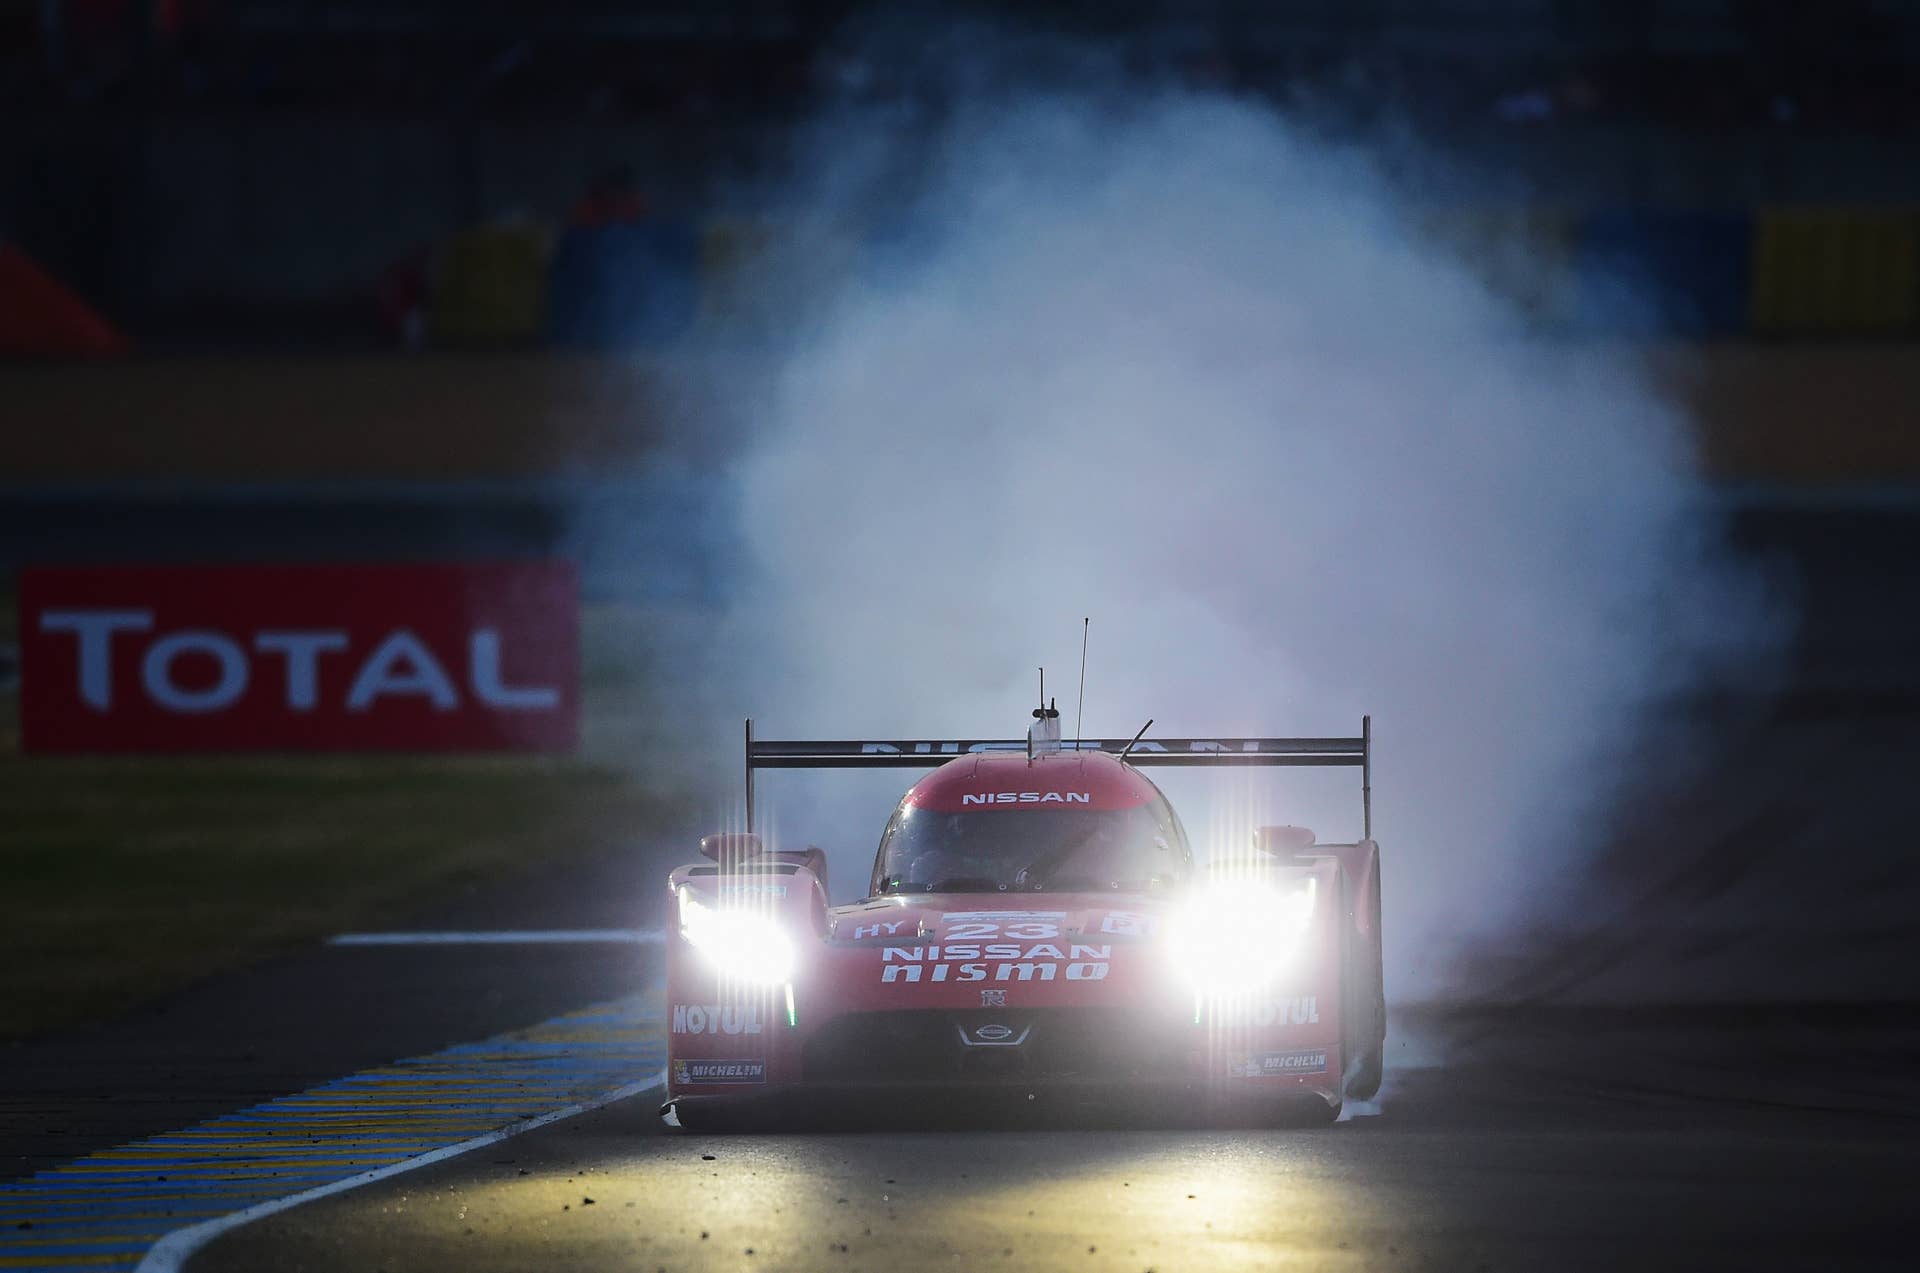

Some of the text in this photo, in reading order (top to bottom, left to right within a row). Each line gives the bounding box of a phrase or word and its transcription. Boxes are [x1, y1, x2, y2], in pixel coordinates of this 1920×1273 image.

[39, 609, 560, 712] TOTAL
[963, 792, 1090, 805] NISSAN
[854, 920, 905, 939] HY
[944, 922, 1060, 940] 23
[882, 944, 1111, 961] NISSAN
[673, 1004, 763, 1034] MOTUL
[1253, 995, 1319, 1025] OTUL
[692, 1064, 763, 1076] MICHELIN
[1264, 1054, 1327, 1068] MICHELIN
